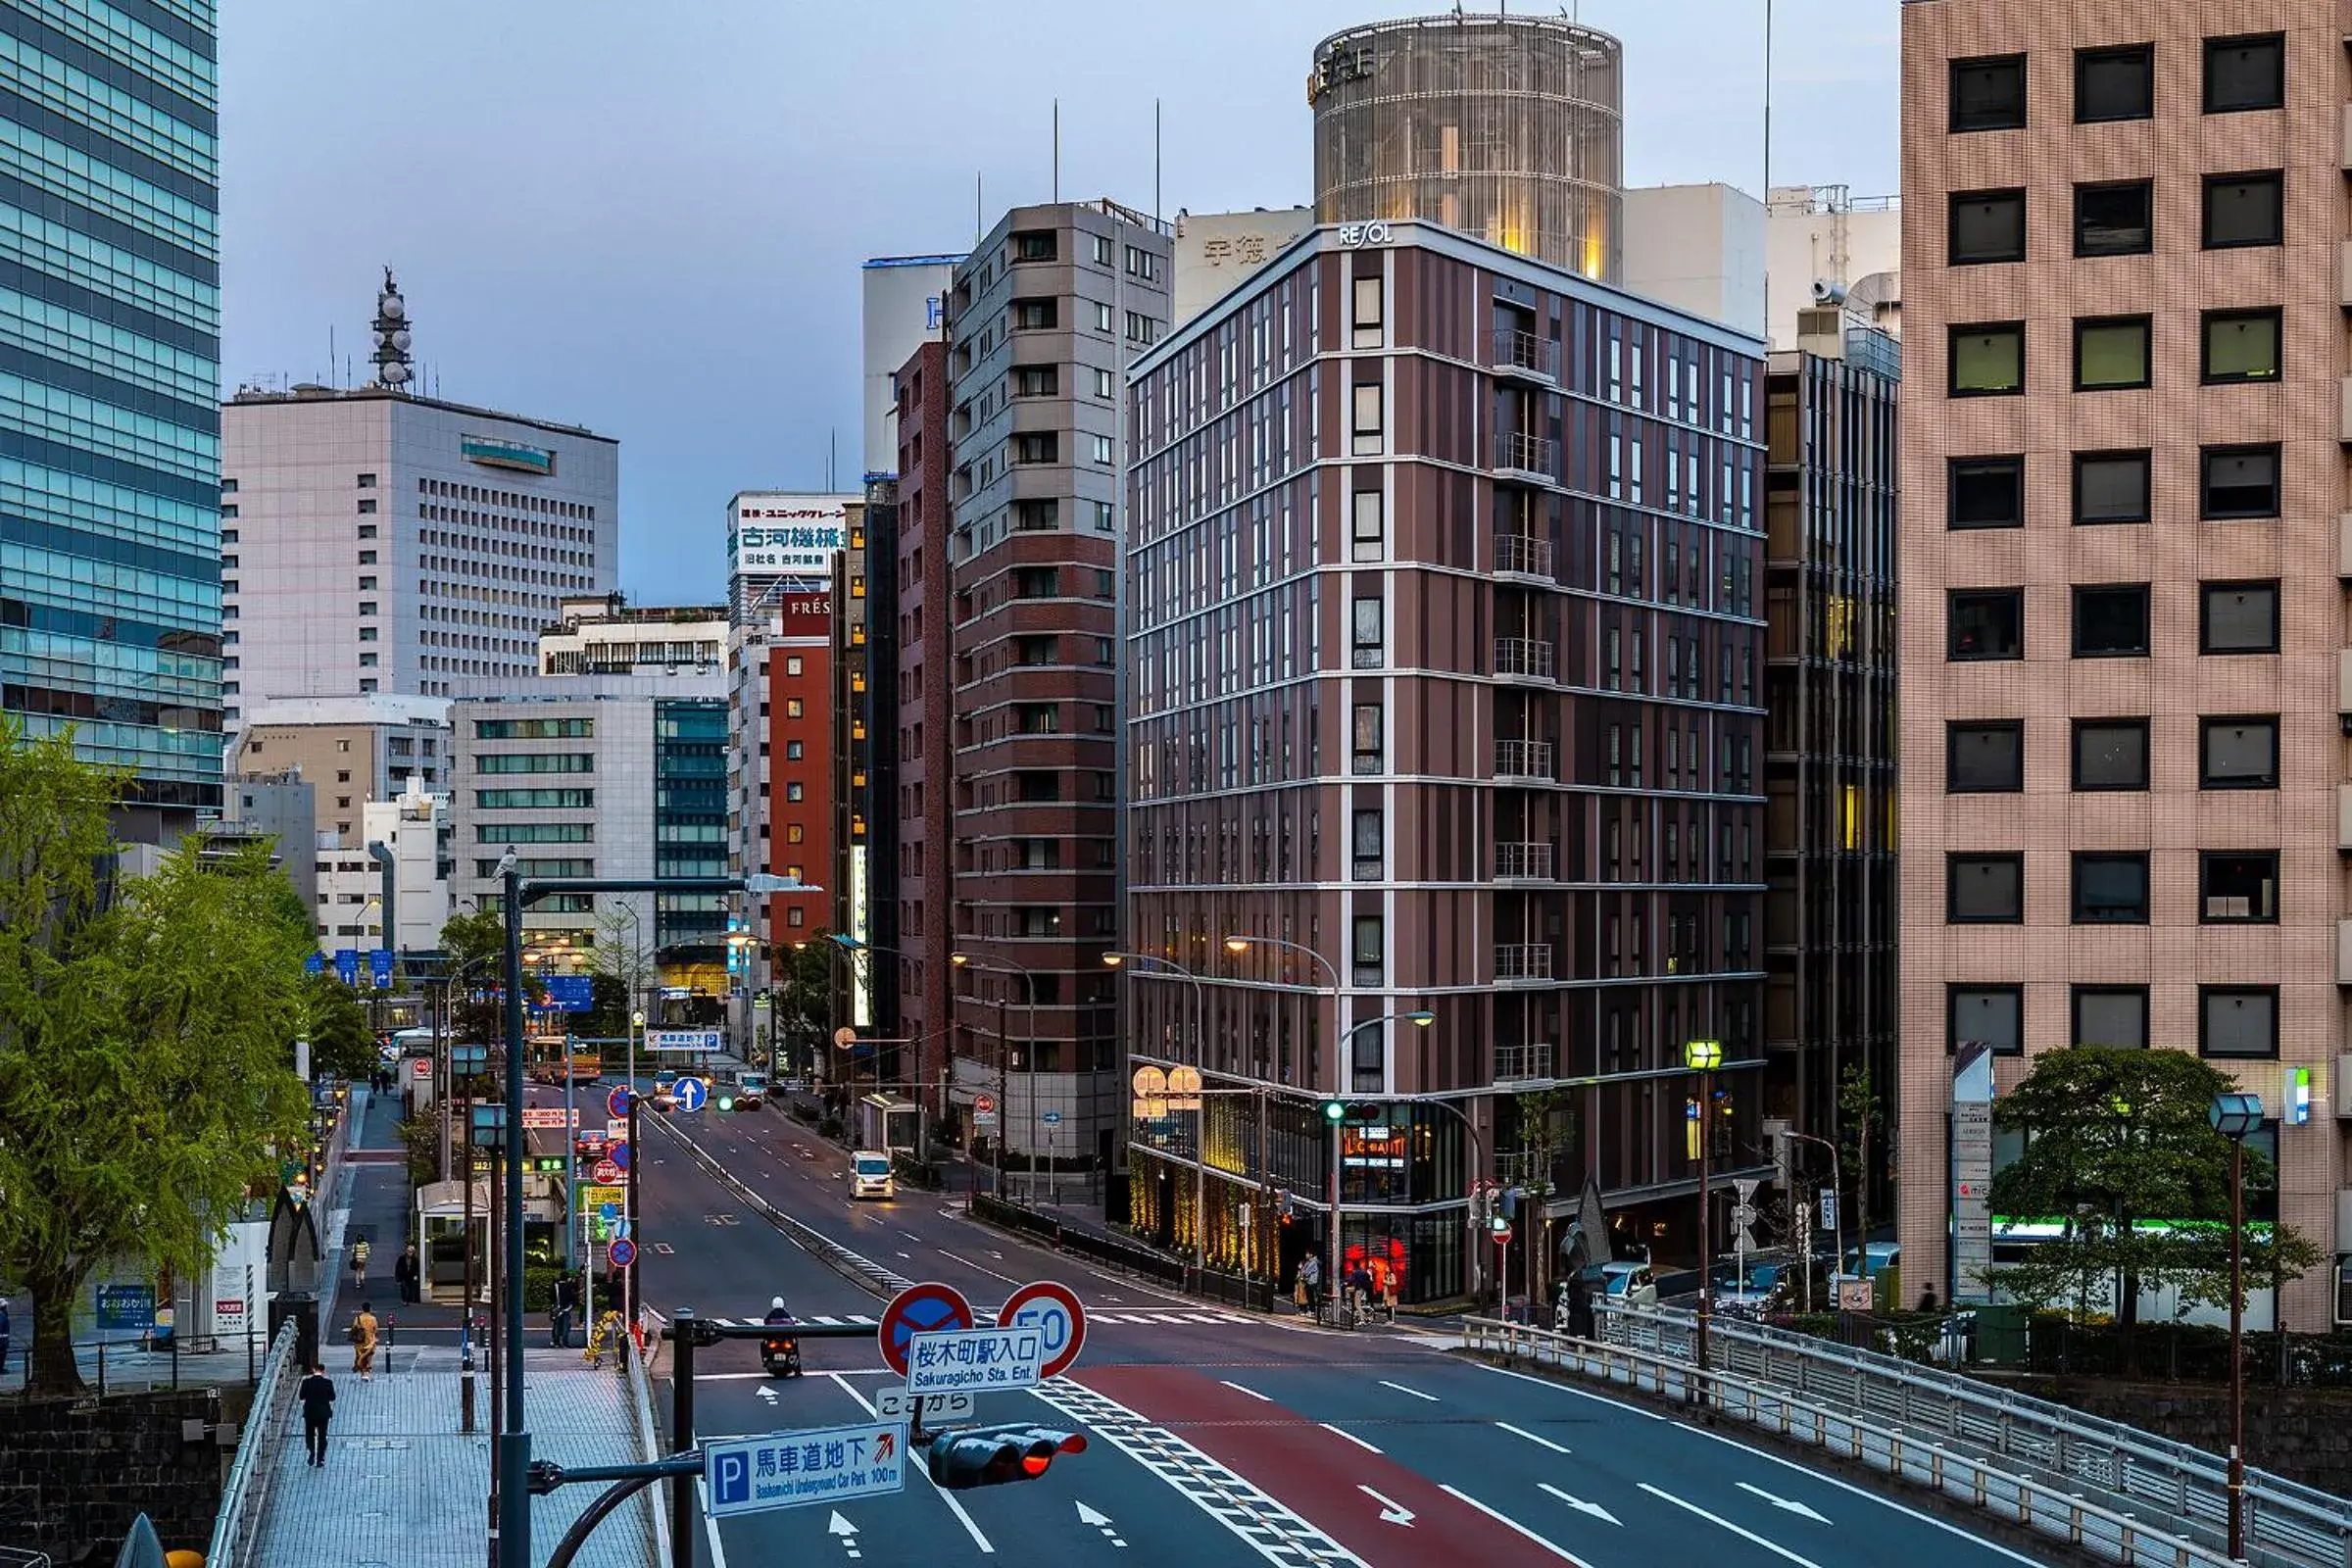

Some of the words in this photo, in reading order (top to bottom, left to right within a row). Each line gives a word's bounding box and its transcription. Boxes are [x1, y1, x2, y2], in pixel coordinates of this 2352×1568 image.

[1340, 219, 1394, 248] RESOL
[915, 1336, 1037, 1368] 桜木町駅入口
[914, 1369, 984, 1388] Sakuragicho
[987, 1367, 1007, 1381] Sta.
[1012, 1366, 1033, 1381] Ent.
[722, 1457, 742, 1500] P
[756, 1437, 866, 1478] 馬車道地下
[756, 1481, 795, 1500] Bashamichi
[795, 1476, 837, 1495] Underground
[838, 1473, 850, 1488] Car
[851, 1470, 866, 1487] Park
[871, 1466, 898, 1484] 100m
